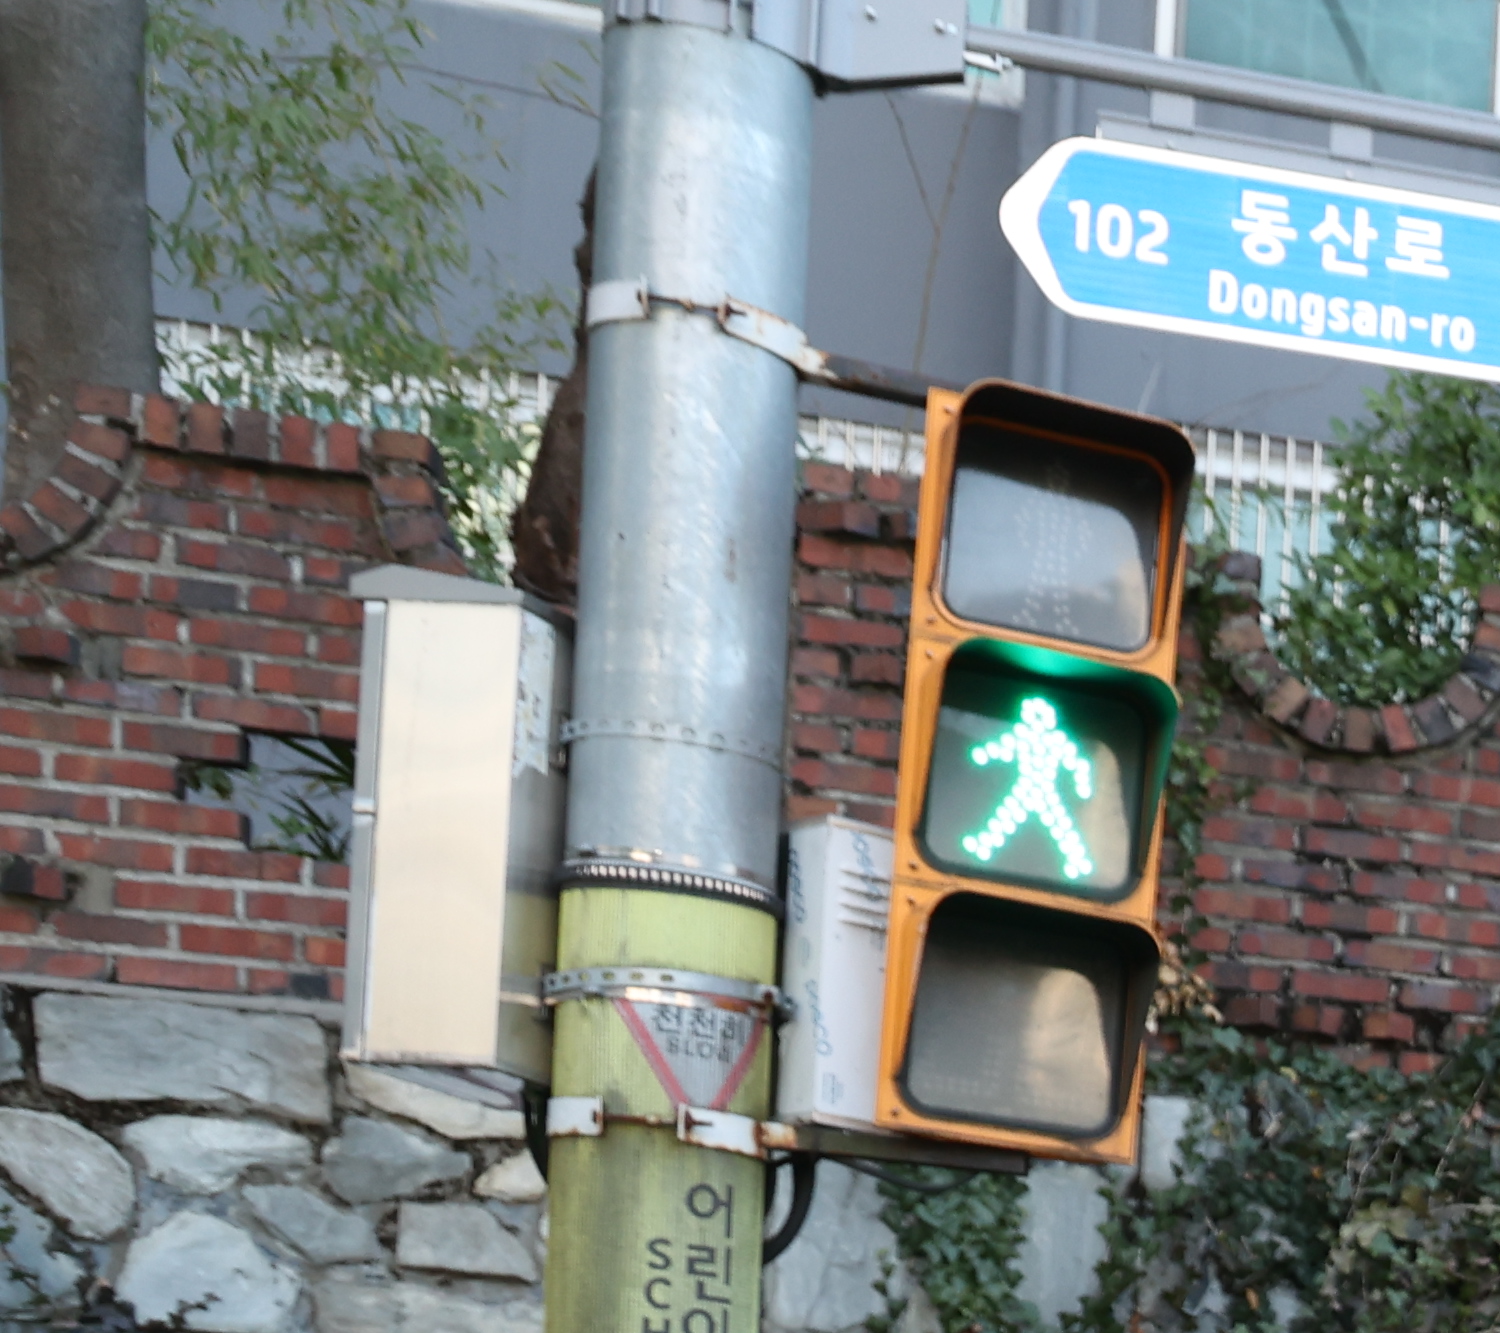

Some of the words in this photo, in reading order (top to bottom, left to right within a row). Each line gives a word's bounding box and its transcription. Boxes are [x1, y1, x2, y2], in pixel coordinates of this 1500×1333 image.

[1067, 199, 1169, 265] 102
[1232, 188, 1450, 280] 동산로
[1209, 270, 1476, 351] Dongsan-ro
